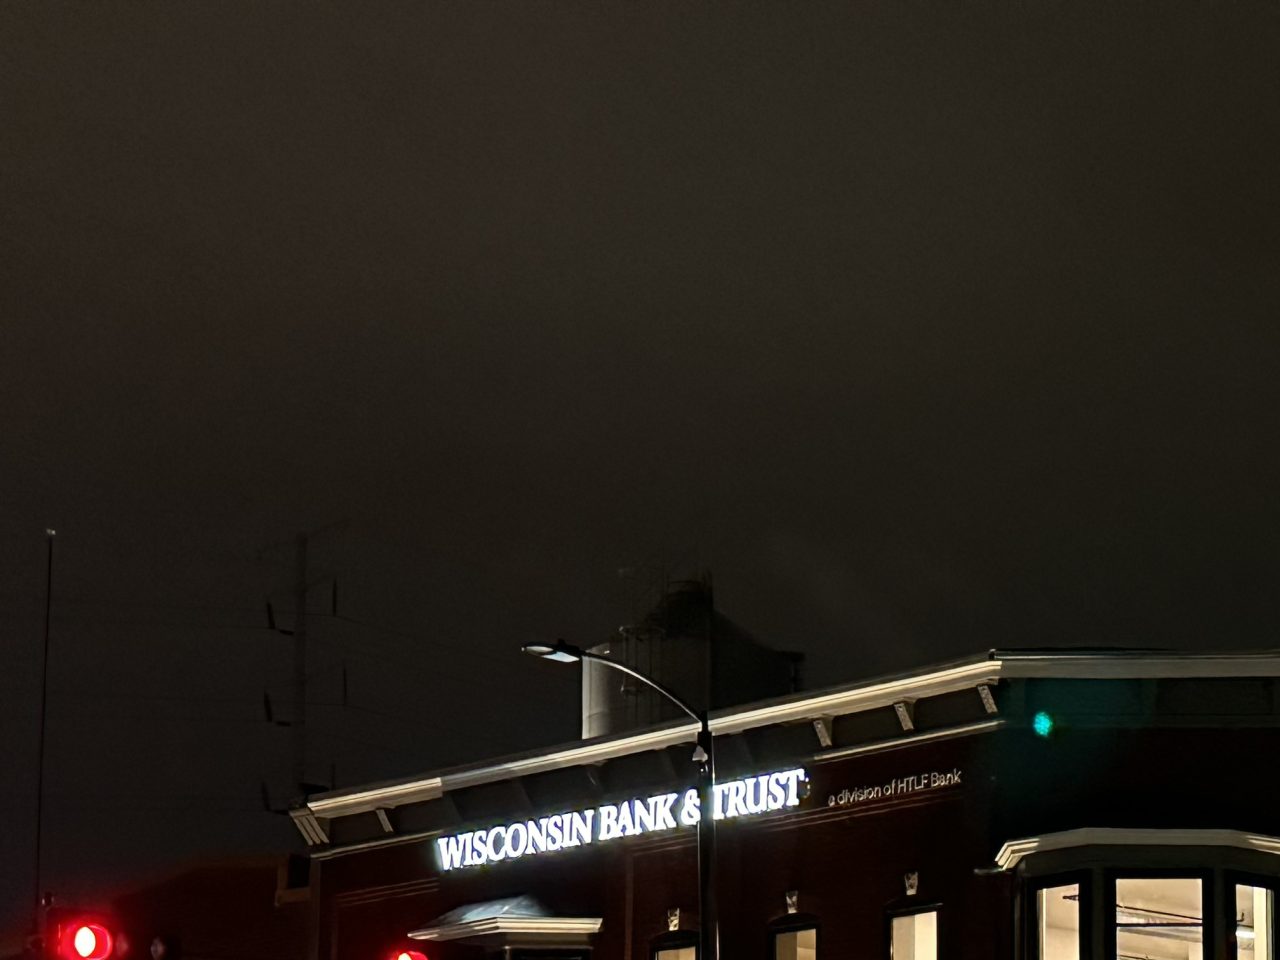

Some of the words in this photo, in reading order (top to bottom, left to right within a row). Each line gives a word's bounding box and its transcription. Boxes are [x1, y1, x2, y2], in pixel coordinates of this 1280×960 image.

[437, 809, 595, 871] WISCONSIN
[598, 793, 678, 841] BANK
[680, 788, 701, 826] &
[712, 768, 806, 821] TRUST
[828, 795, 836, 807] a
[837, 786, 882, 805] division
[883, 778, 896, 796] of
[897, 774, 929, 794] HTLF
[930, 768, 962, 787] Bank
